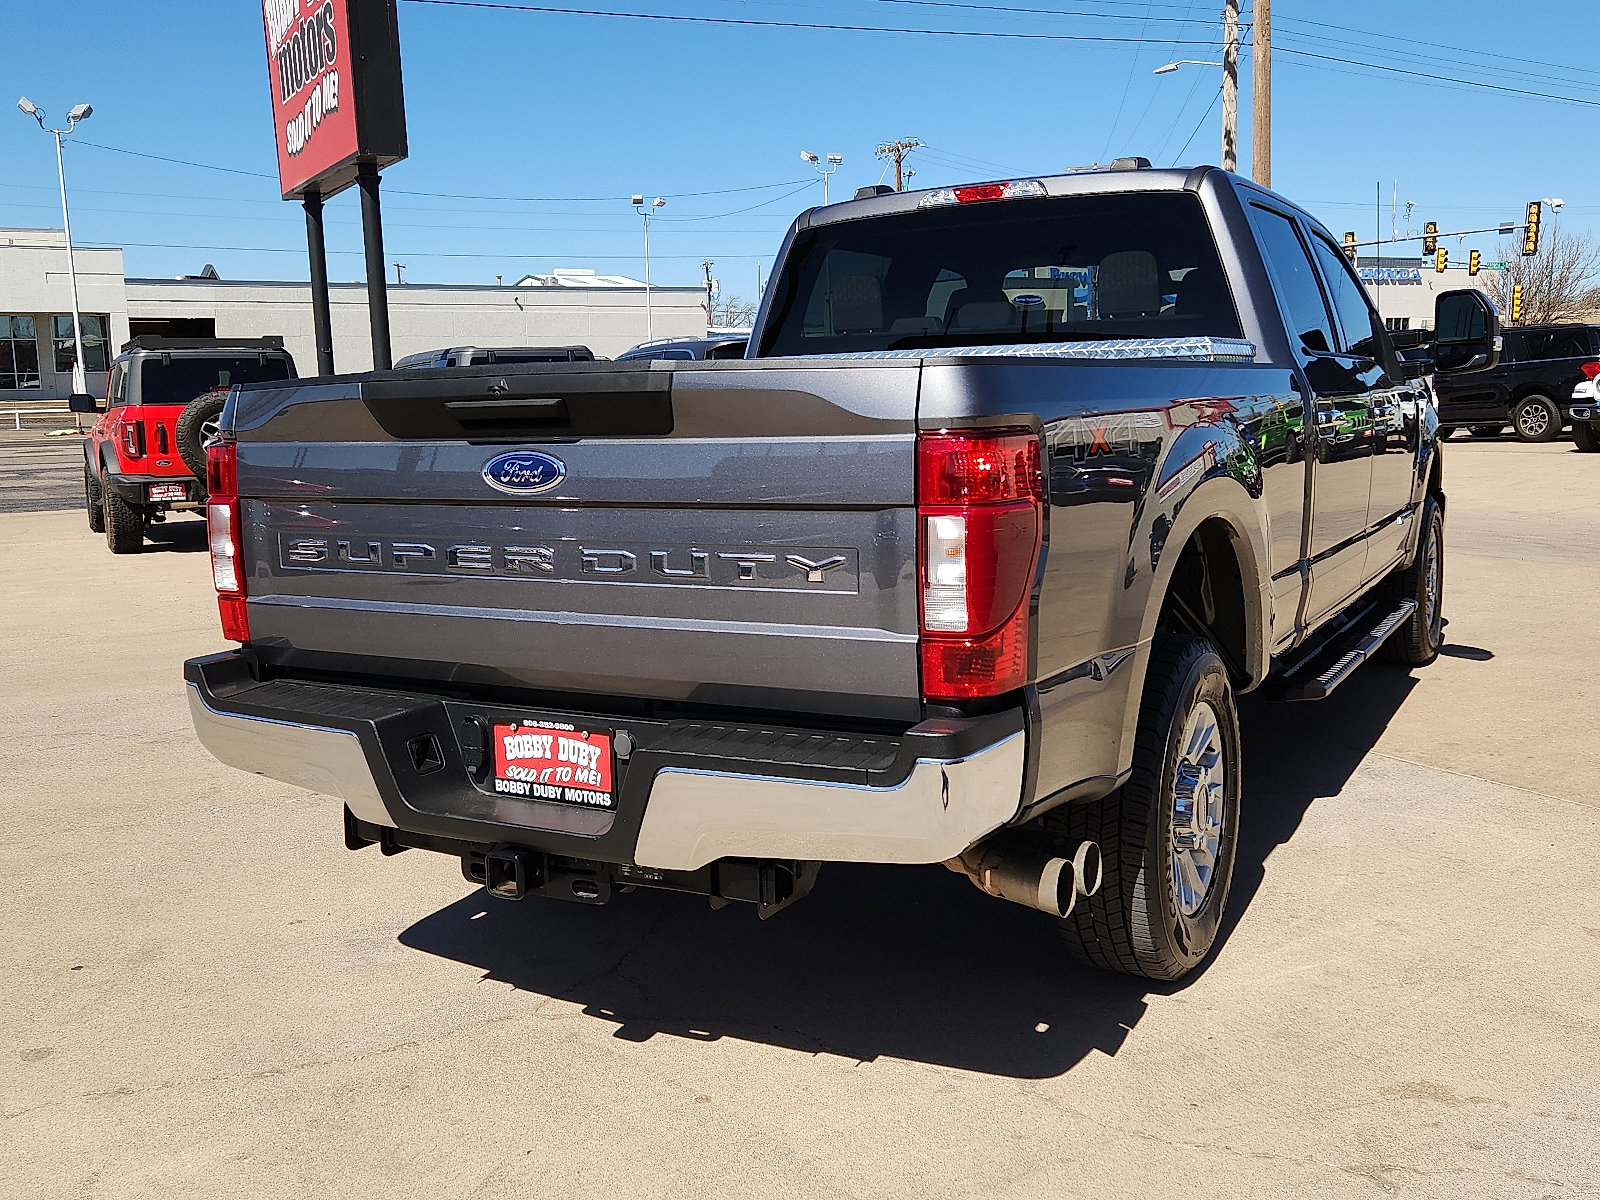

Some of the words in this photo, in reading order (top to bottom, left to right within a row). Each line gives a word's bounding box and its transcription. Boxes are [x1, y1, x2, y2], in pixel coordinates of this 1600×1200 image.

[278, 0, 337, 105] motors
[286, 110, 304, 157] SOLD
[311, 82, 322, 131] TO
[1360, 268, 1422, 282] HONDA
[500, 460, 545, 483] Ford
[288, 538, 556, 574] SUPER
[579, 546, 847, 582] DUTY
[503, 734, 553, 761] BOBBY
[557, 736, 602, 770] DUBY
[505, 765, 538, 783] SOLD
[539, 768, 554, 783] IT
[555, 767, 573, 783] TO
[574, 769, 602, 787] ME!
[494, 779, 532, 796] BOBBY
[533, 783, 563, 799] DUBY
[564, 788, 612, 807] MOTORS
